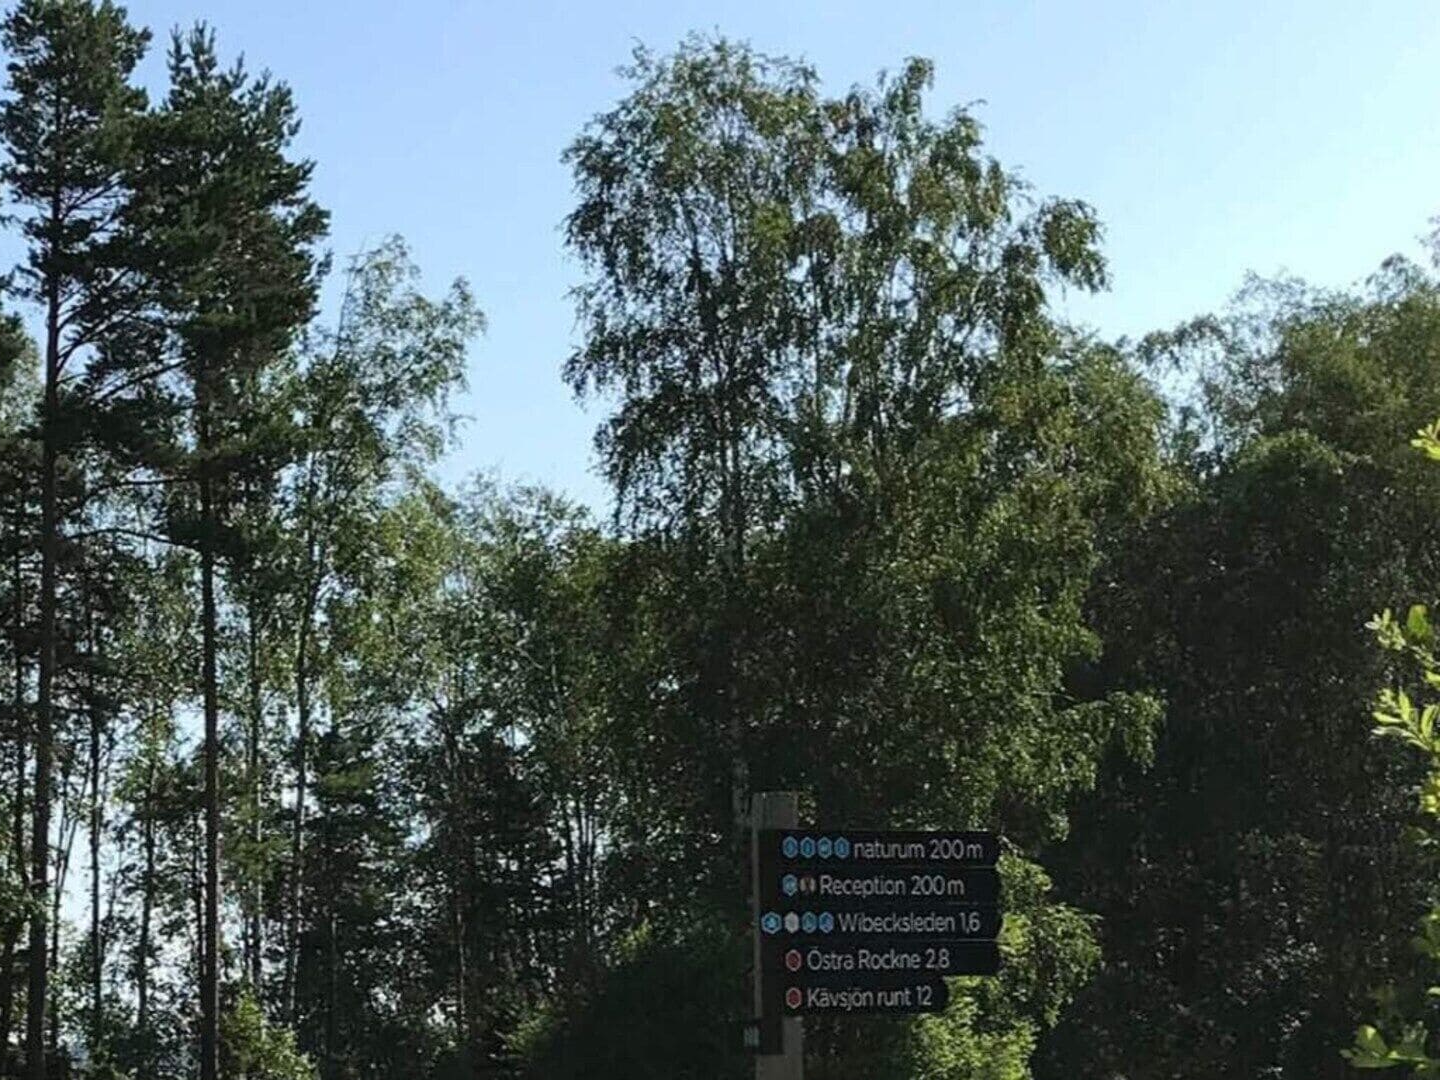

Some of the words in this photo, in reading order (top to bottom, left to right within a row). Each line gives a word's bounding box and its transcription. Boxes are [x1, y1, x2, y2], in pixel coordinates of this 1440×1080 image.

[853, 840, 925, 860] naturum
[819, 874, 906, 898] Reception
[837, 911, 956, 933] Wibecksleden
[806, 946, 854, 971] Östra
[858, 949, 921, 969] Rockne
[807, 987, 874, 1012] Kävsjön
[877, 987, 913, 1006] runt
[915, 985, 933, 1006] 12
